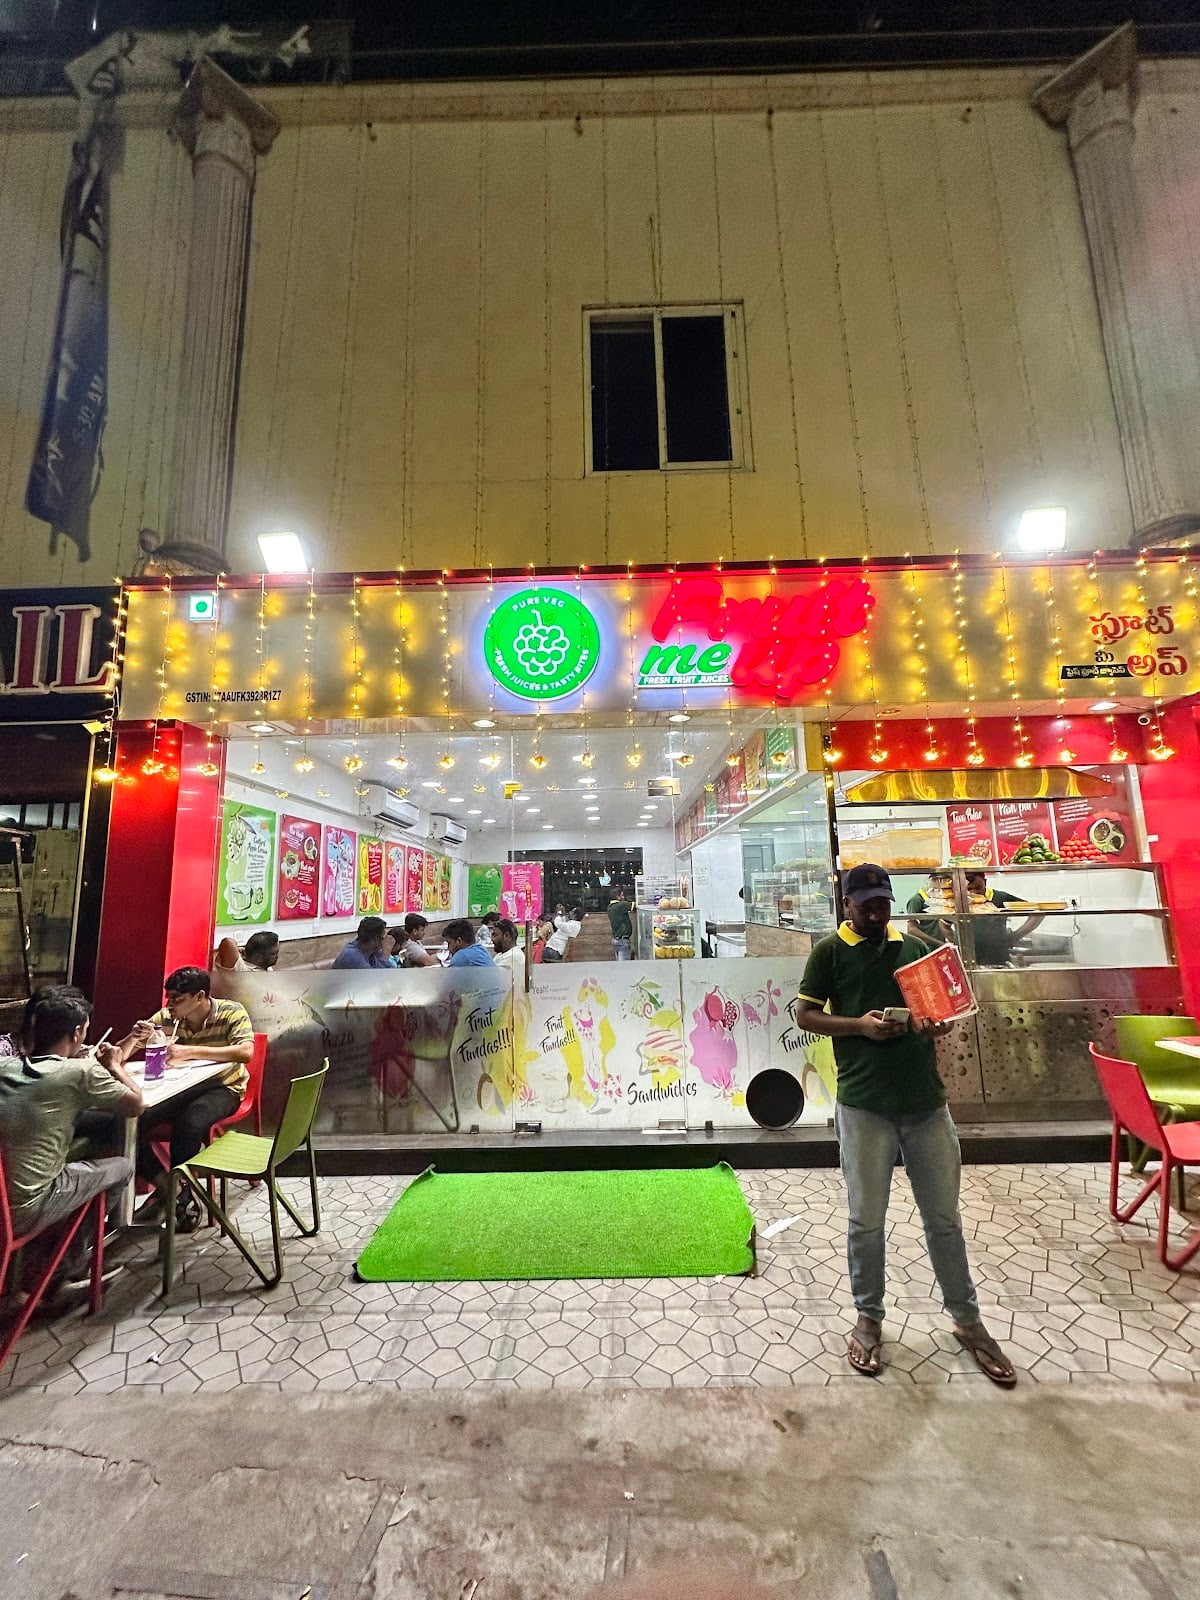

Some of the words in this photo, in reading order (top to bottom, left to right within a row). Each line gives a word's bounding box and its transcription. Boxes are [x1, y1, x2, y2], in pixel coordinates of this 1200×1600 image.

[511, 596, 540, 612] PURE
[543, 596, 566, 608] VEG
[651, 577, 876, 643] Fruit
[0, 604, 119, 694] IL
[639, 642, 733, 675] me
[494, 646, 514, 678] FRESH
[509, 675, 542, 691] JUICES
[550, 672, 577, 690] TASTY
[573, 648, 590, 674] BITES
[643, 675, 671, 685] FRESH
[672, 675, 696, 685] FRUIT
[698, 674, 730, 684] JUICES
[185, 692, 211, 703] GSTIN:
[465, 1007, 497, 1033] Fruit
[543, 1015, 566, 1033] Fruit
[456, 1027, 512, 1064] Fundas!!!
[538, 1031, 576, 1055] Fundas!!!
[627, 1081, 698, 1106] Sandwiches
